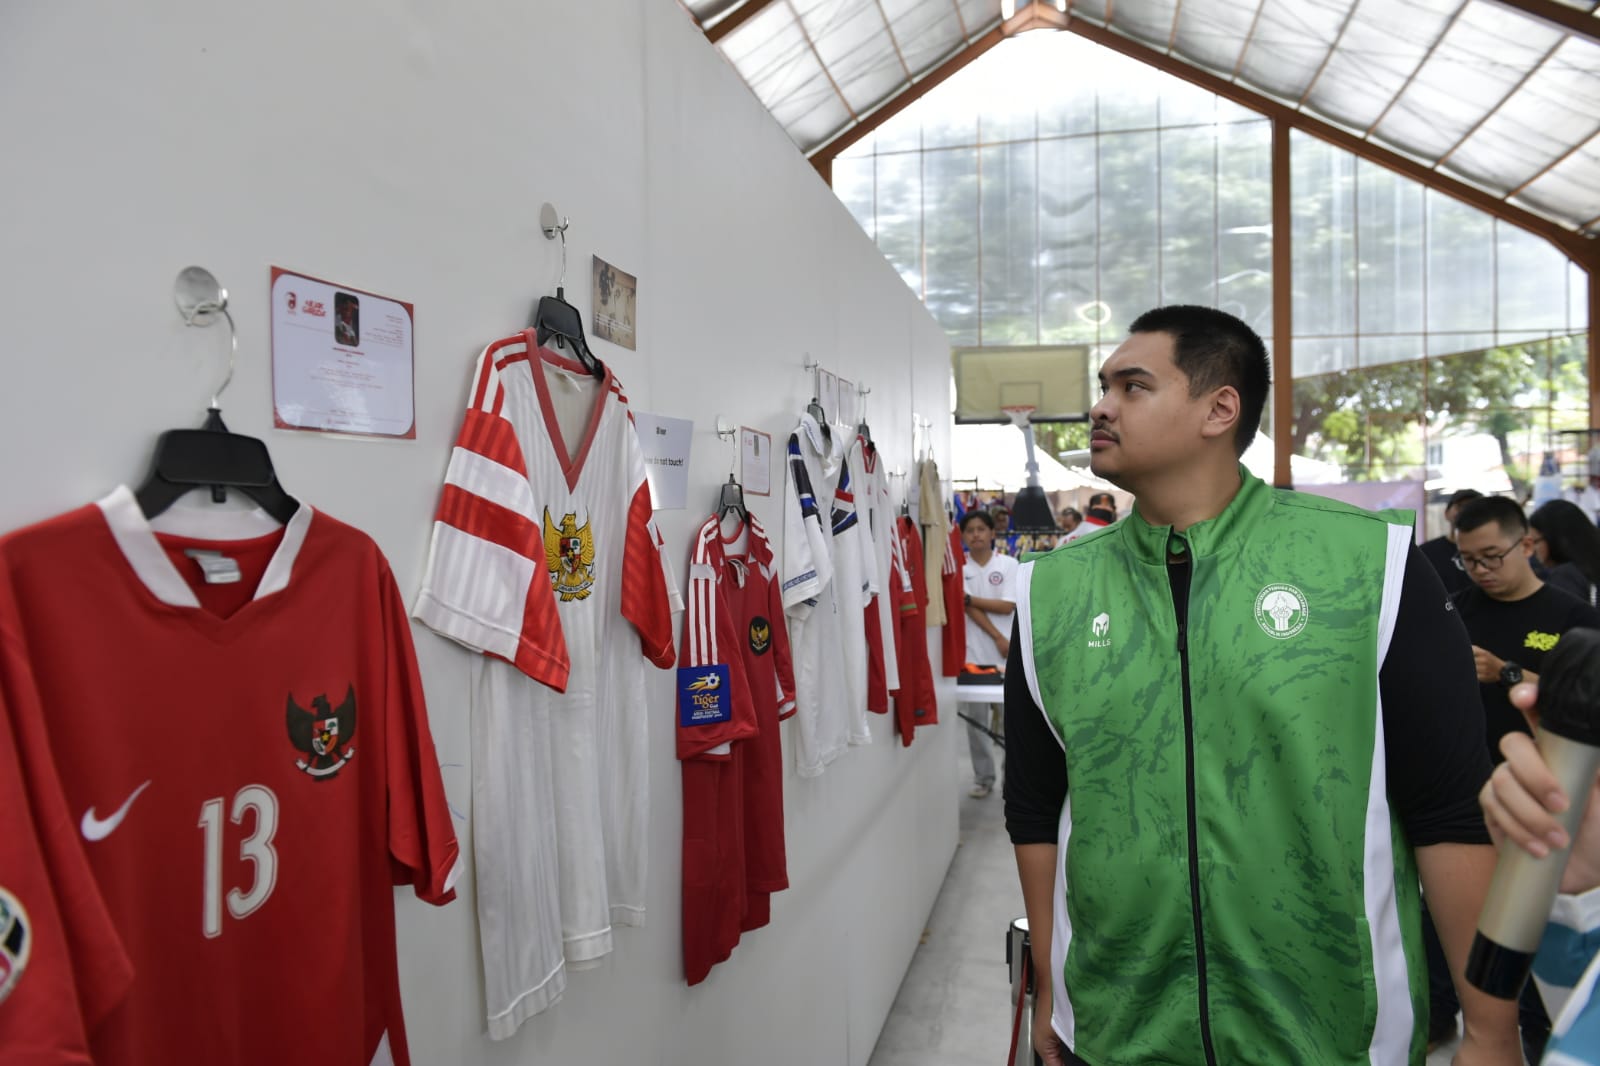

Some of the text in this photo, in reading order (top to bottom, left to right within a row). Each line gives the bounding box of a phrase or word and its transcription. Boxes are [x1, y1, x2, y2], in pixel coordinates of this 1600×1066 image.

[1087, 639, 1111, 648] MILLS
[691, 693, 719, 708] Tiger
[197, 784, 280, 939] 13
